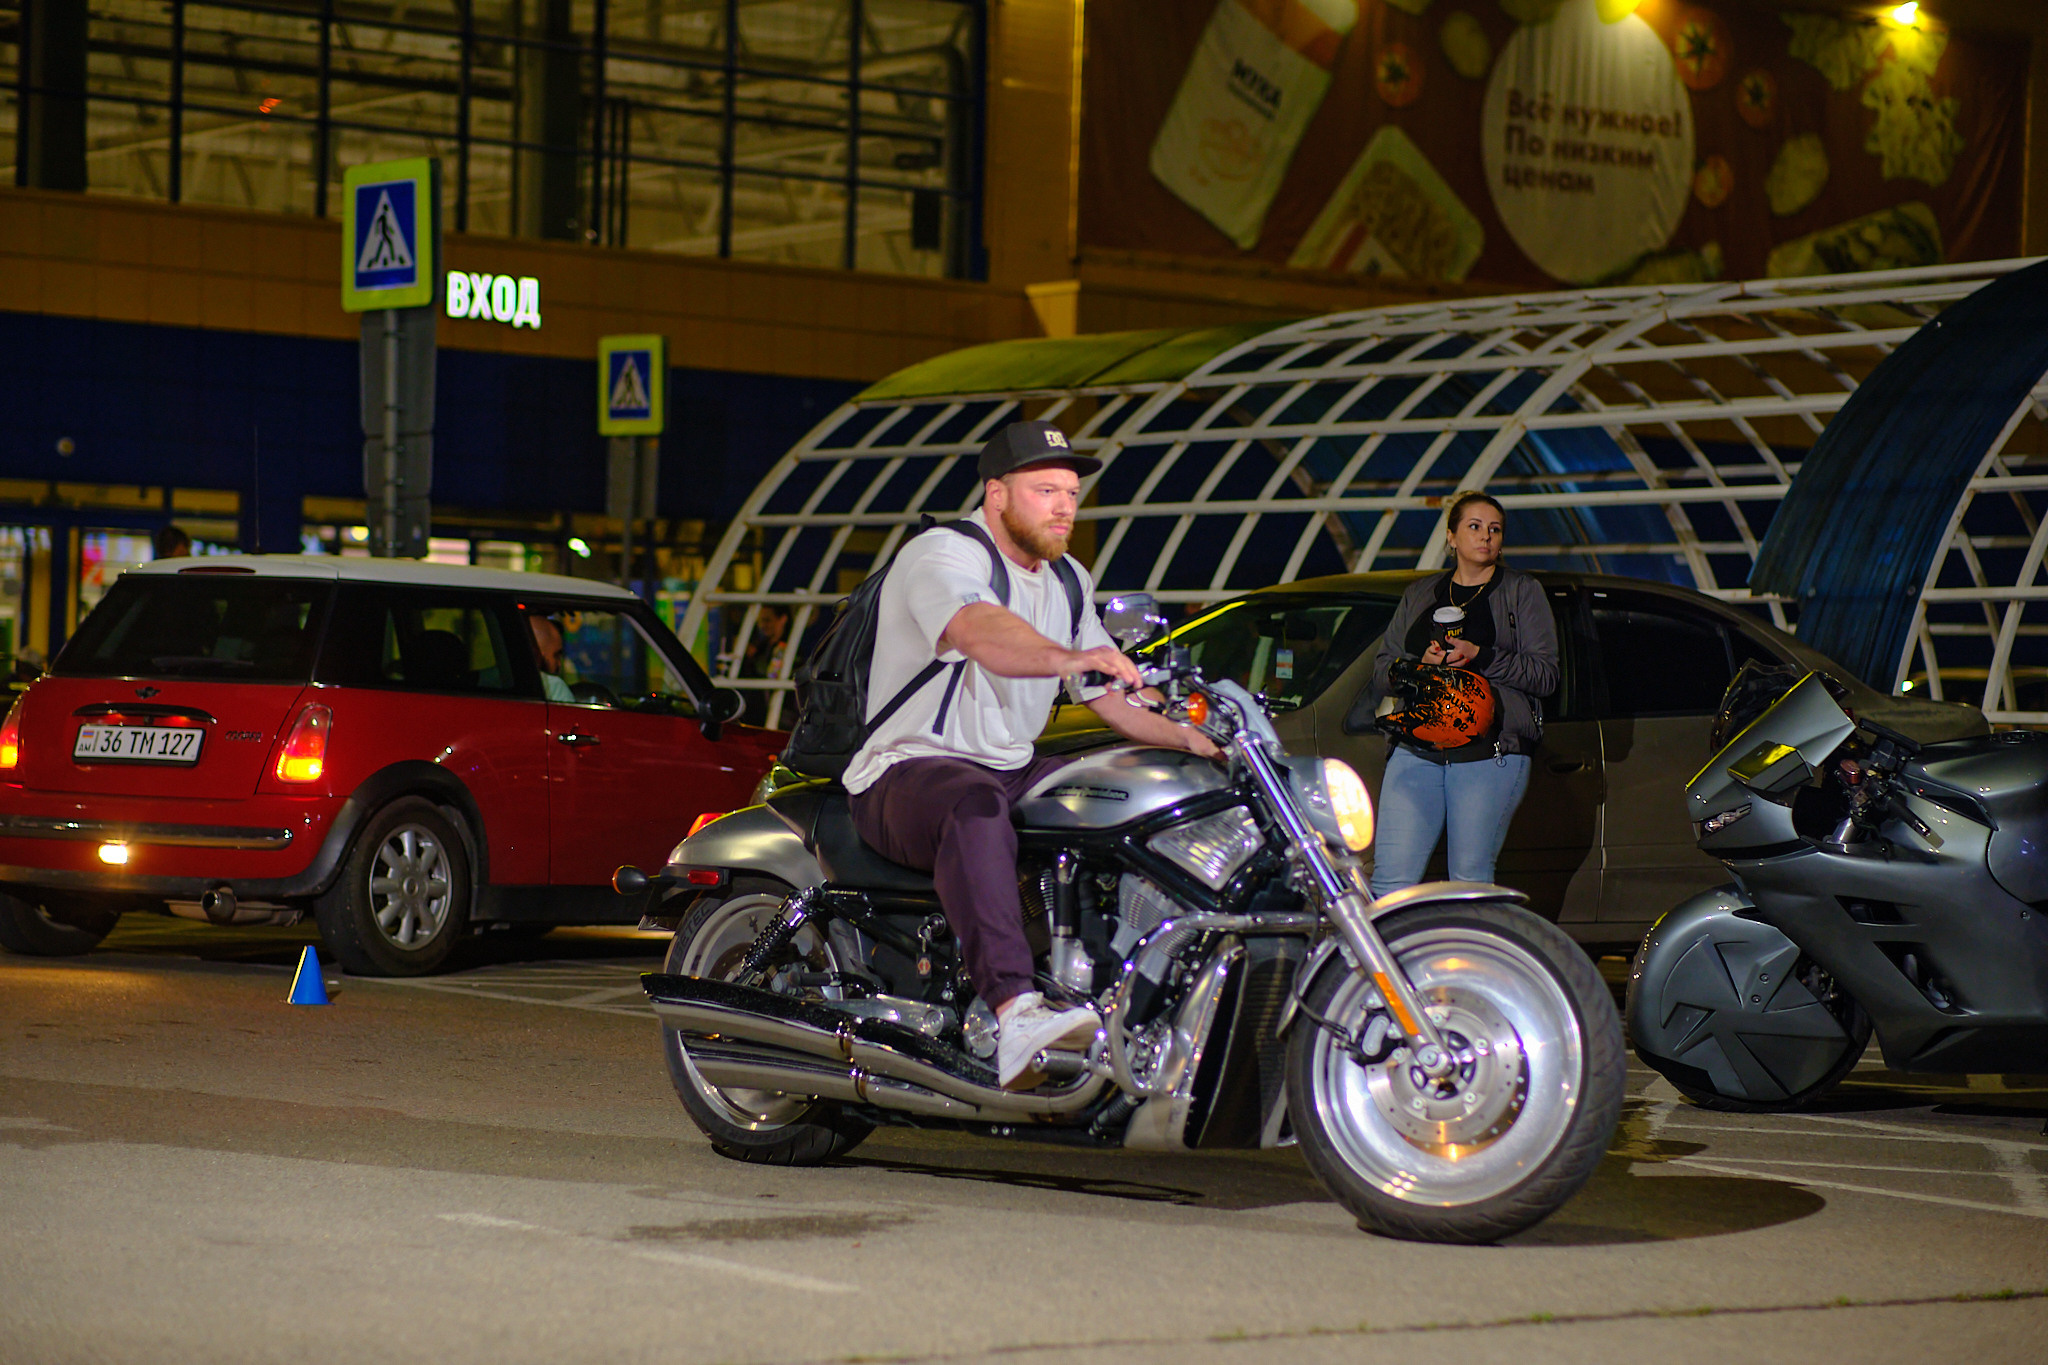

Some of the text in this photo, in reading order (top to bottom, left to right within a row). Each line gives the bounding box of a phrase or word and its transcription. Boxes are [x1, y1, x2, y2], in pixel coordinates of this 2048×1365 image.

[1507, 88, 1682, 137] Всё нужное!
[1504, 124, 1654, 170] По низким
[1503, 164, 1595, 195] ценам
[446, 269, 542, 330] ВХОД
[78, 730, 195, 756] AM 36 TM 127
